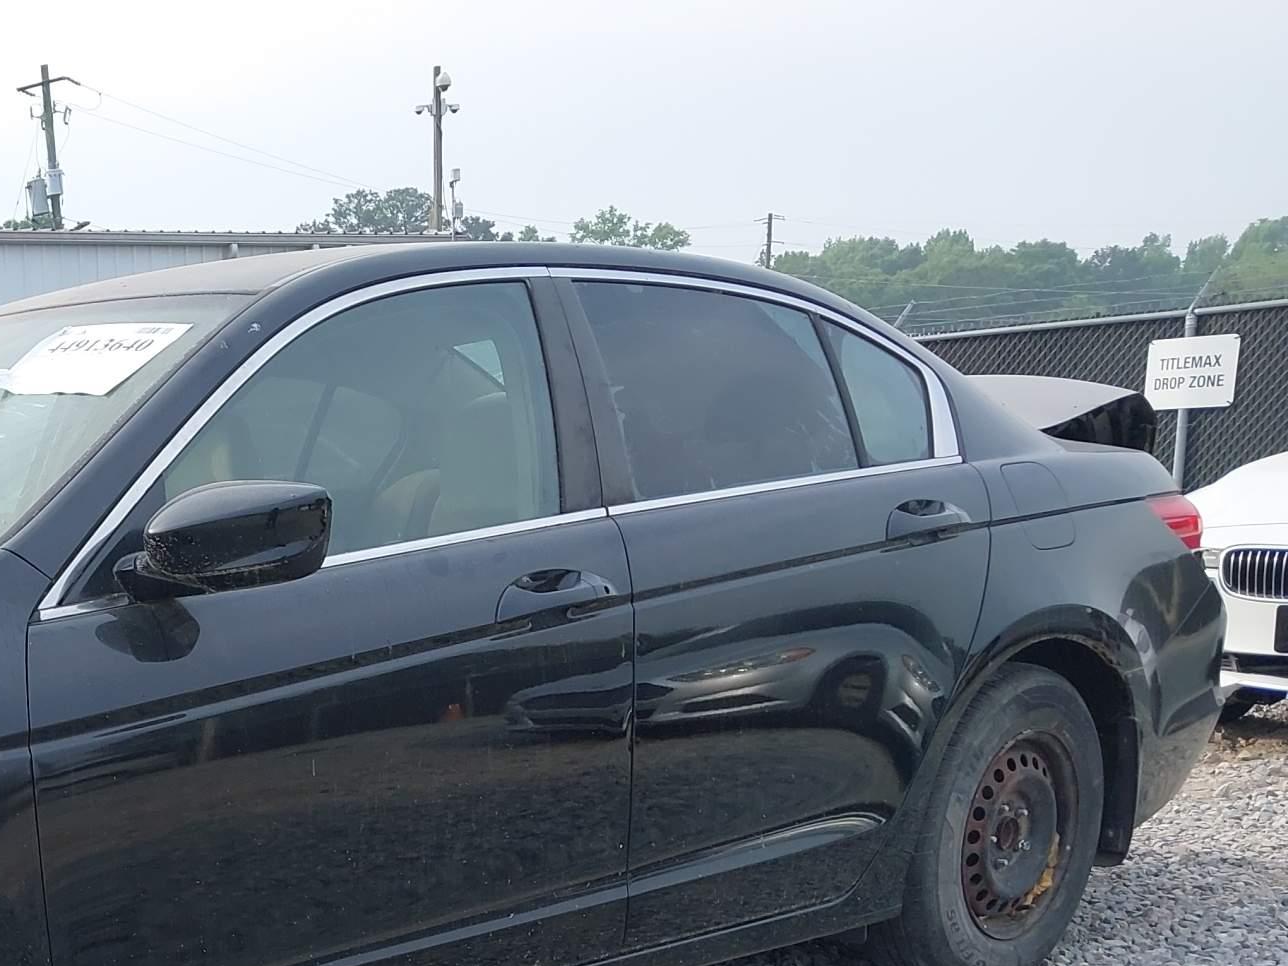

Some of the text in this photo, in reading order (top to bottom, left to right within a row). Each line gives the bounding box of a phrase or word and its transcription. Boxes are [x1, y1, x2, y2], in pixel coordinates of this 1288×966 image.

[1160, 354, 1223, 371] TITLEMAX
[1153, 373, 1225, 391] DROP ZONE
